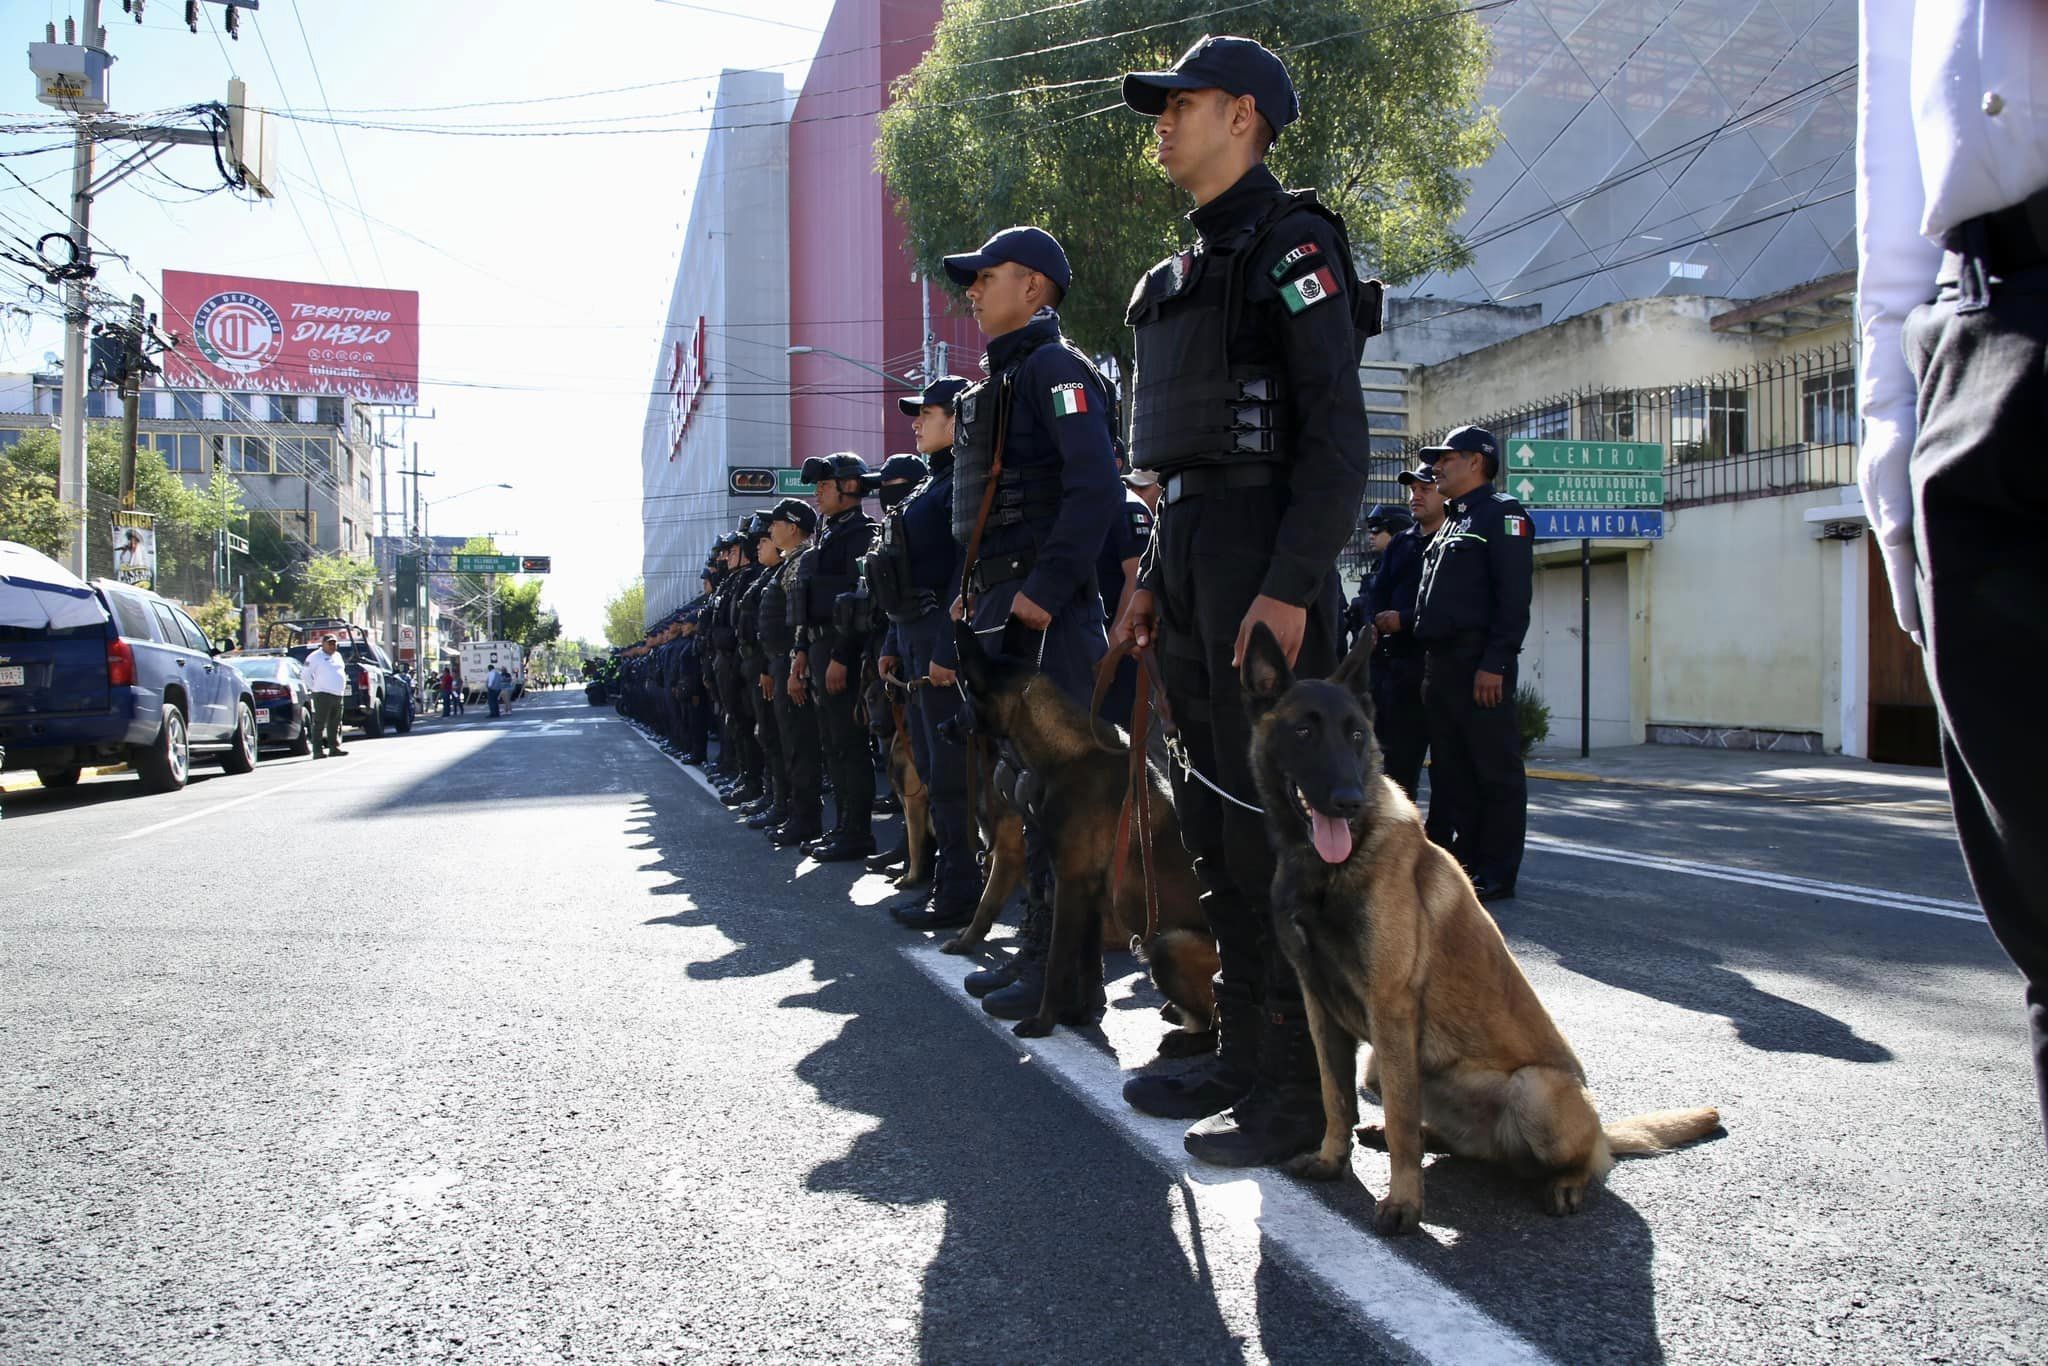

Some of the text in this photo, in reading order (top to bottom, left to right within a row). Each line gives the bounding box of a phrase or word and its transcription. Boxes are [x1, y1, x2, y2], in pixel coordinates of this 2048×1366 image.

[197, 295, 280, 331] CLUB DEPORTIVO
[291, 304, 391, 322] TERRITORIO
[291, 321, 391, 345] DIABLO
[1553, 446, 1634, 465] CENTRO
[1559, 477, 1647, 489] PROCURADURIA
[1547, 490, 1599, 502] GENERAL
[1607, 491, 1627, 502] DEL
[1549, 515, 1639, 533] ALAMEDA
